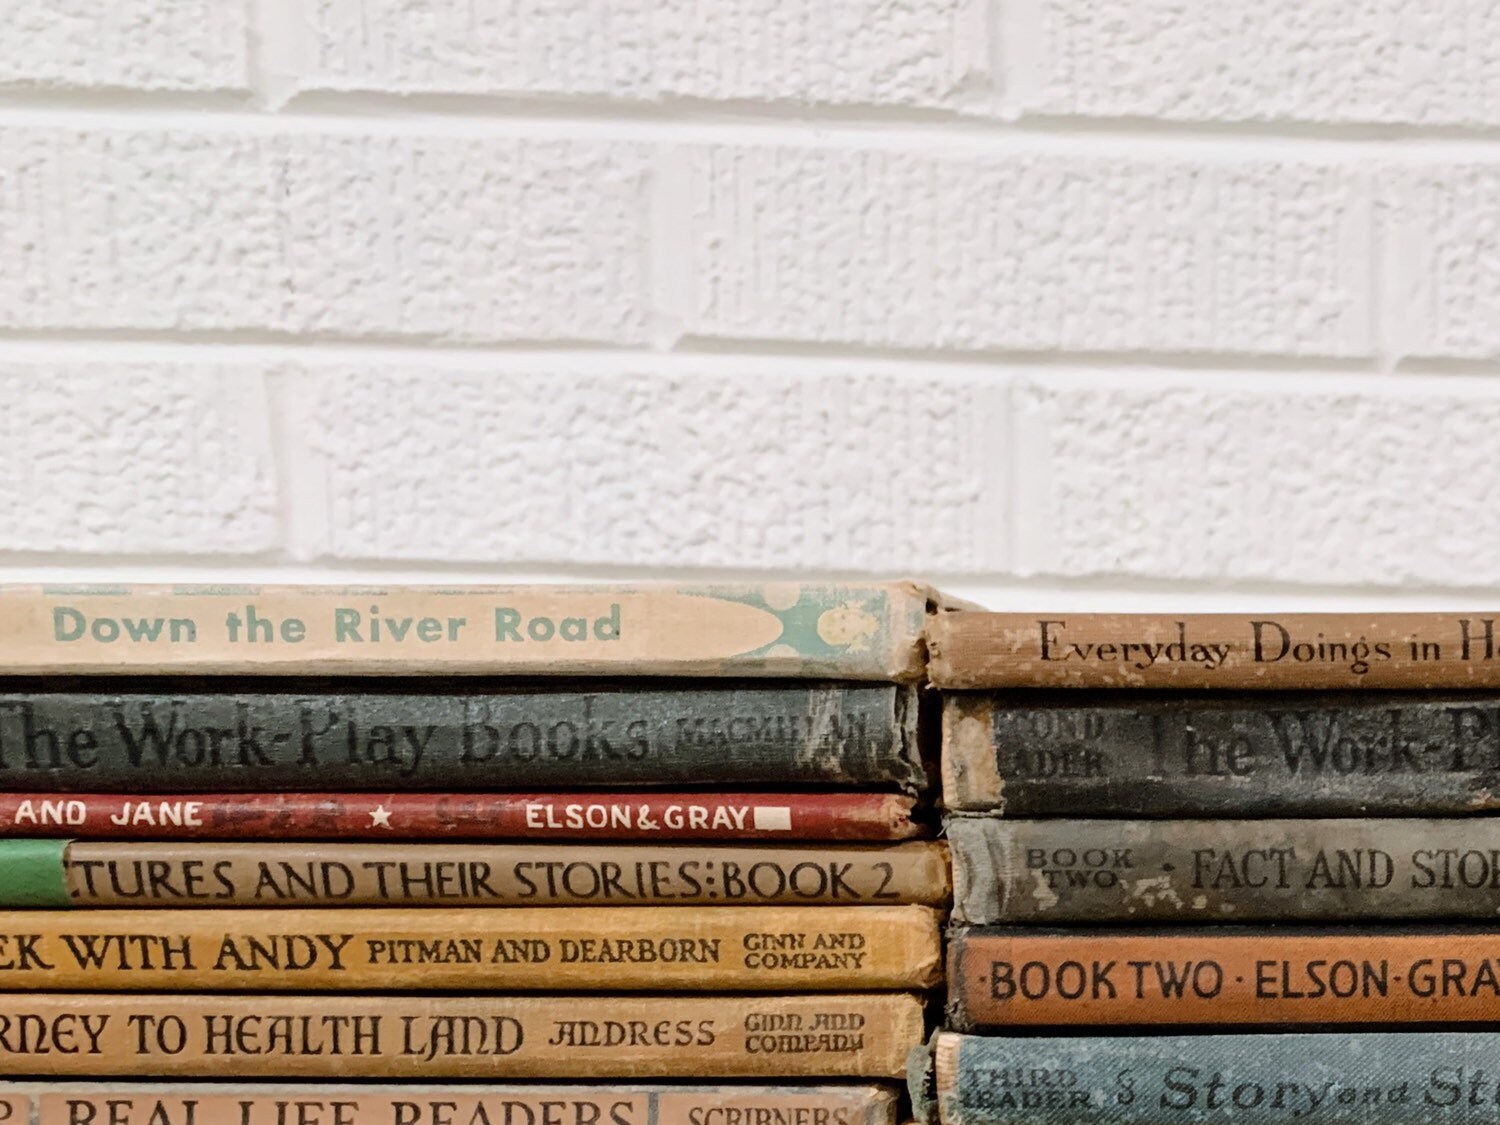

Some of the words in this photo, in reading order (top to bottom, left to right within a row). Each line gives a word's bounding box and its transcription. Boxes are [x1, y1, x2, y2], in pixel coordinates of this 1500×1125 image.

[53, 605, 197, 643] Down
[225, 605, 307, 643] the
[334, 605, 467, 643] River
[493, 604, 622, 642] Road
[1037, 619, 1233, 670] Everyday
[1250, 620, 1392, 675] Doings
[1410, 633, 1442, 662] in
[459, 695, 651, 763] Books
[14, 799, 87, 825] AND
[110, 801, 204, 827] JANE
[1026, 847, 1135, 870] BOOK
[1190, 848, 1297, 891] FACT
[1305, 848, 1396, 891] AND
[253, 861, 356, 898] AND
[361, 861, 505, 898] THEIR
[722, 862, 862, 898] BOOK
[872, 862, 900, 898] 2
[1041, 869, 1118, 889] TWO
[60, 933, 198, 971] WITH
[211, 933, 356, 971] ANDY
[366, 939, 482, 964] PITMAN
[490, 938, 551, 964] AND
[559, 938, 722, 964] DEARBORN
[742, 933, 806, 951] GINN
[812, 933, 866, 950] AND
[743, 951, 869, 970] COMPANY
[991, 960, 1117, 1000] BOOK
[1126, 960, 1225, 999] TWO
[127, 1014, 189, 1056] TO
[202, 1014, 383, 1056] HEALTH
[399, 1014, 525, 1062] LAND
[548, 1020, 718, 1048] ANDRESS
[810, 1012, 865, 1032] AND
[743, 1031, 865, 1055] COMPANY
[1160, 1065, 1337, 1118] Story
[1339, 1080, 1410, 1105] and
